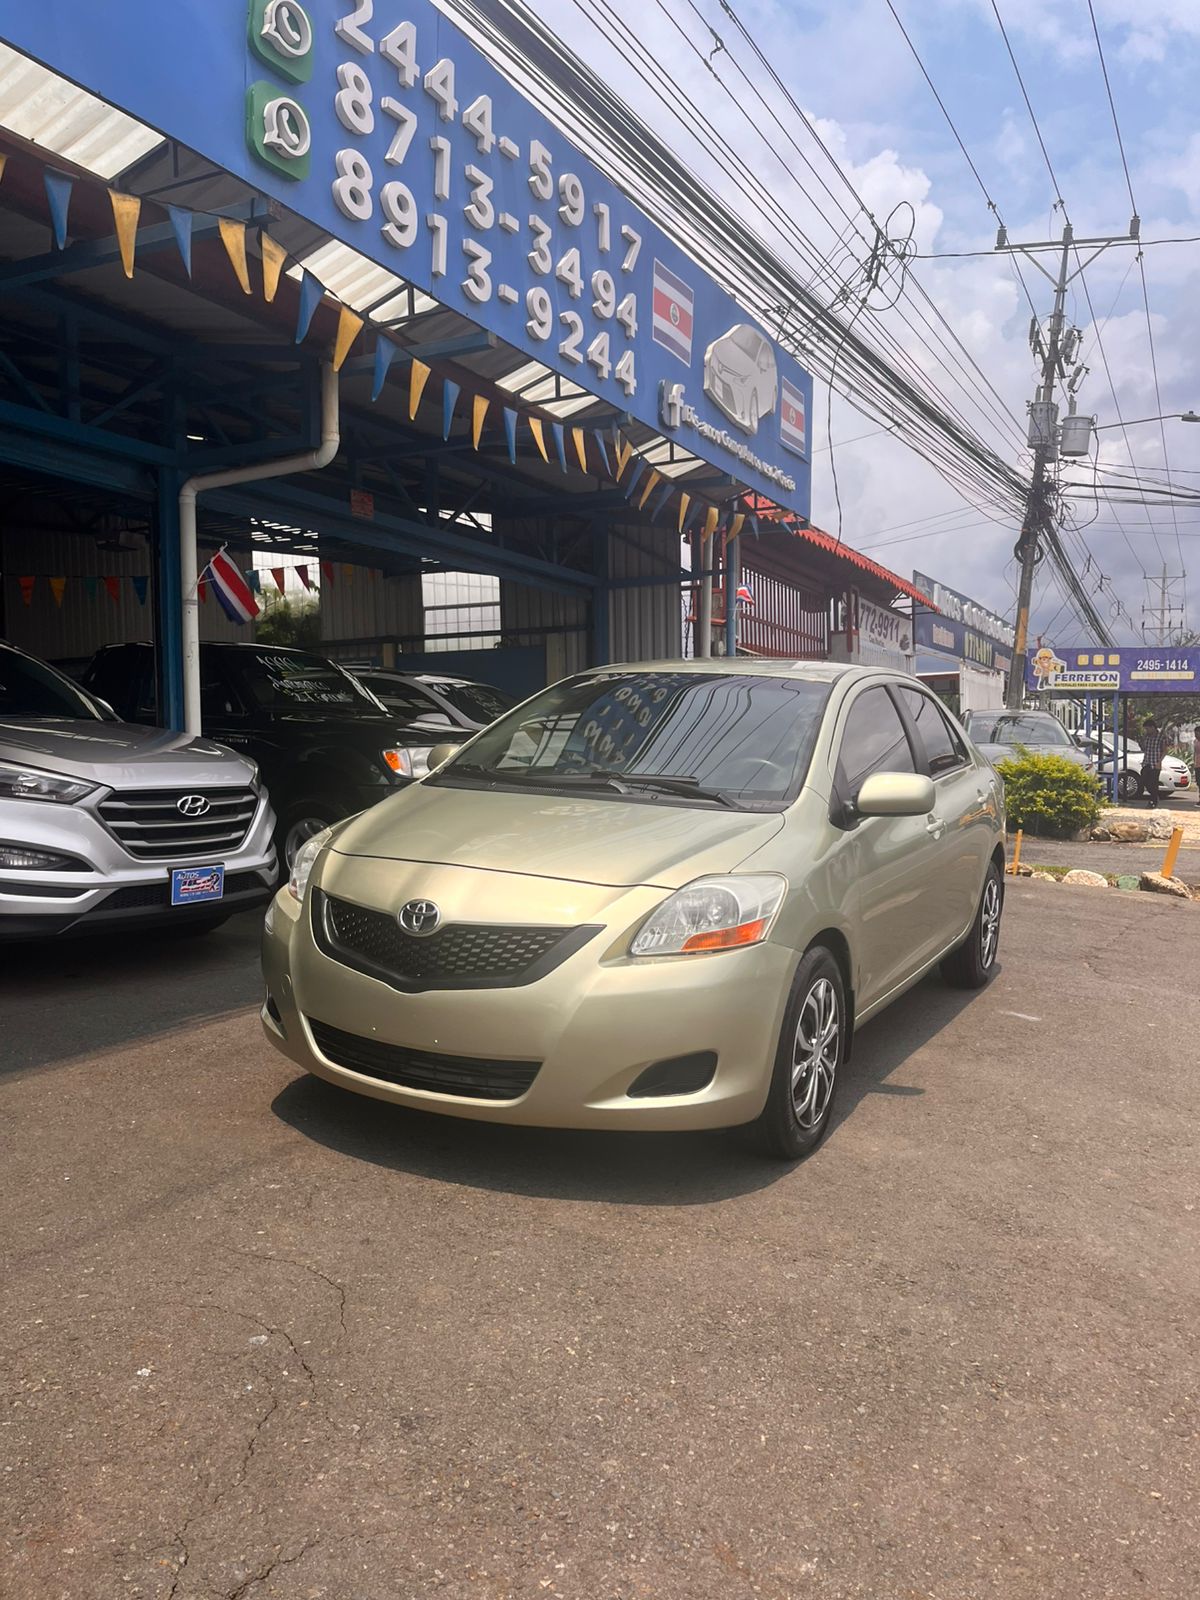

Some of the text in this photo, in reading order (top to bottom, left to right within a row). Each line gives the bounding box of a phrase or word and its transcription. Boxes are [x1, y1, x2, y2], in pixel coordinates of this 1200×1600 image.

[335, 0, 642, 273] 2444-5917
[335, 61, 638, 339] 8713-3494
[332, 148, 637, 396] 8913-9244
[1054, 672, 1118, 682] FERRETÓN
[1136, 659, 1189, 671] 2495-1414
[176, 871, 200, 880] AUTOS
